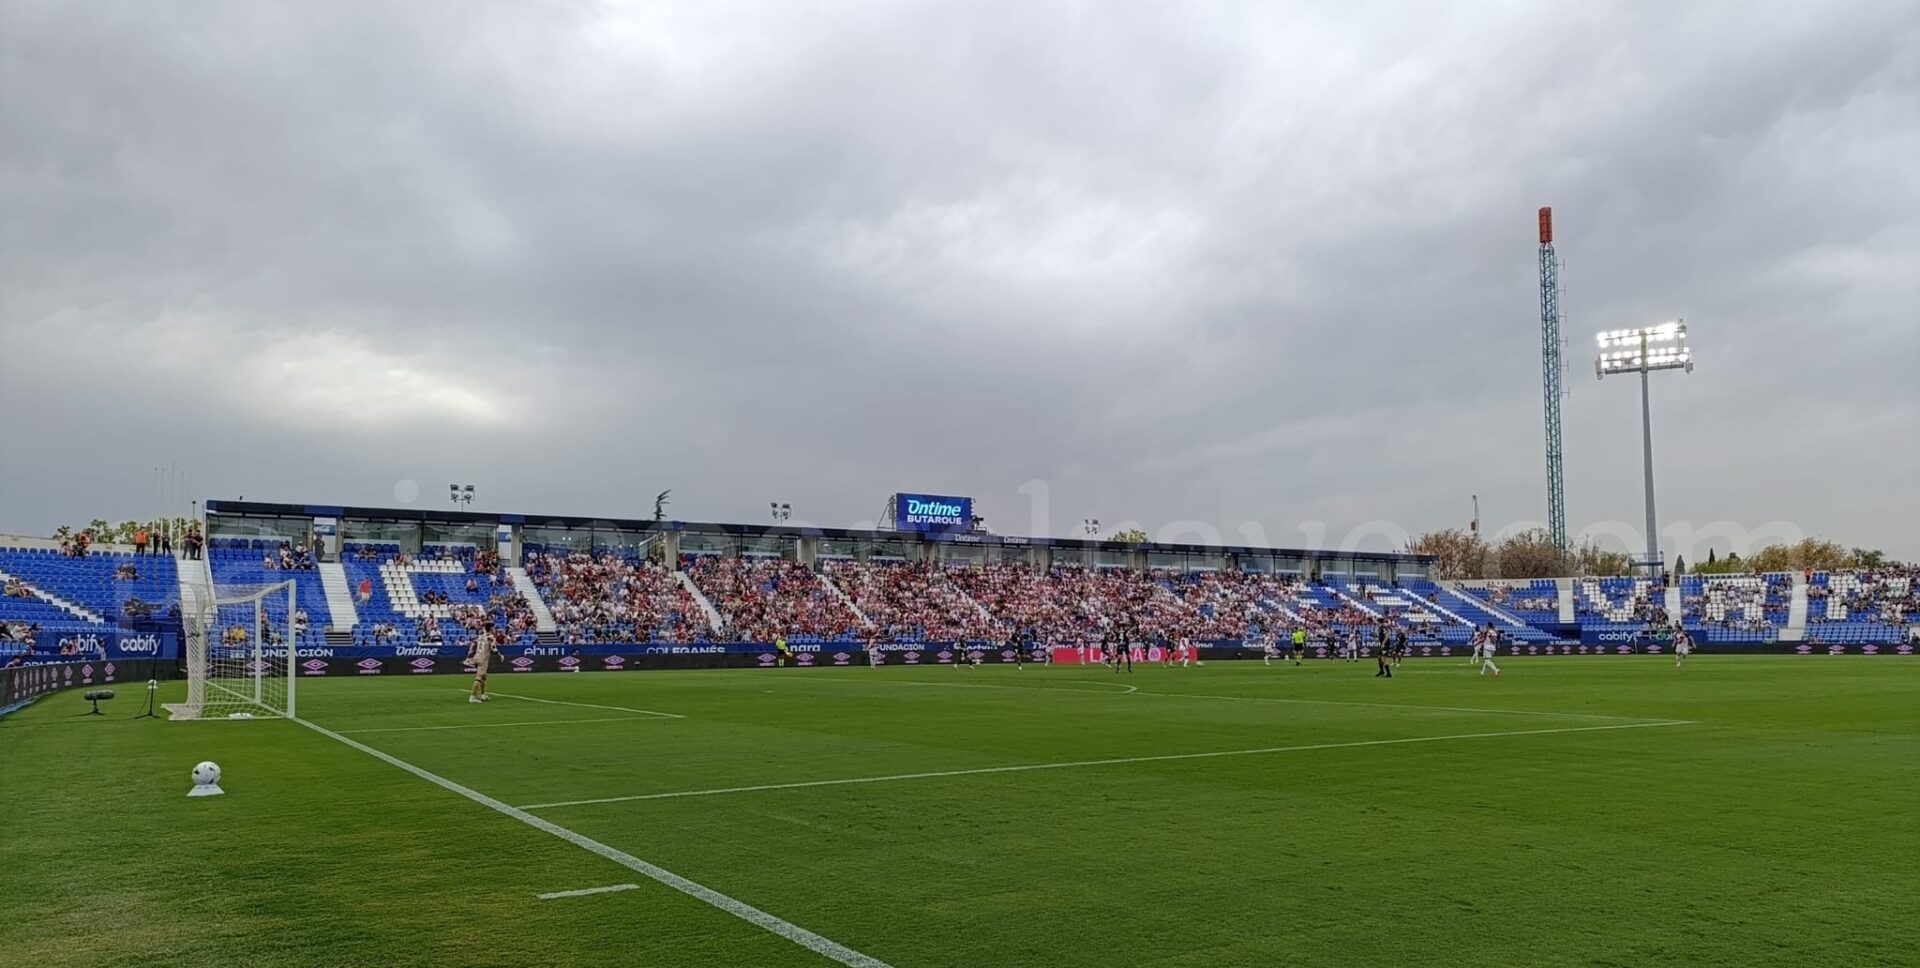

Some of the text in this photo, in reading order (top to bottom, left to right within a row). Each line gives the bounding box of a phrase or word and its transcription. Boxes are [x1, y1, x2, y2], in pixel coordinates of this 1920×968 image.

[907, 500, 961, 516] Ontime
[1598, 631, 1634, 643] cabify
[120, 634, 161, 655] cabify
[396, 646, 439, 656] Ontime
